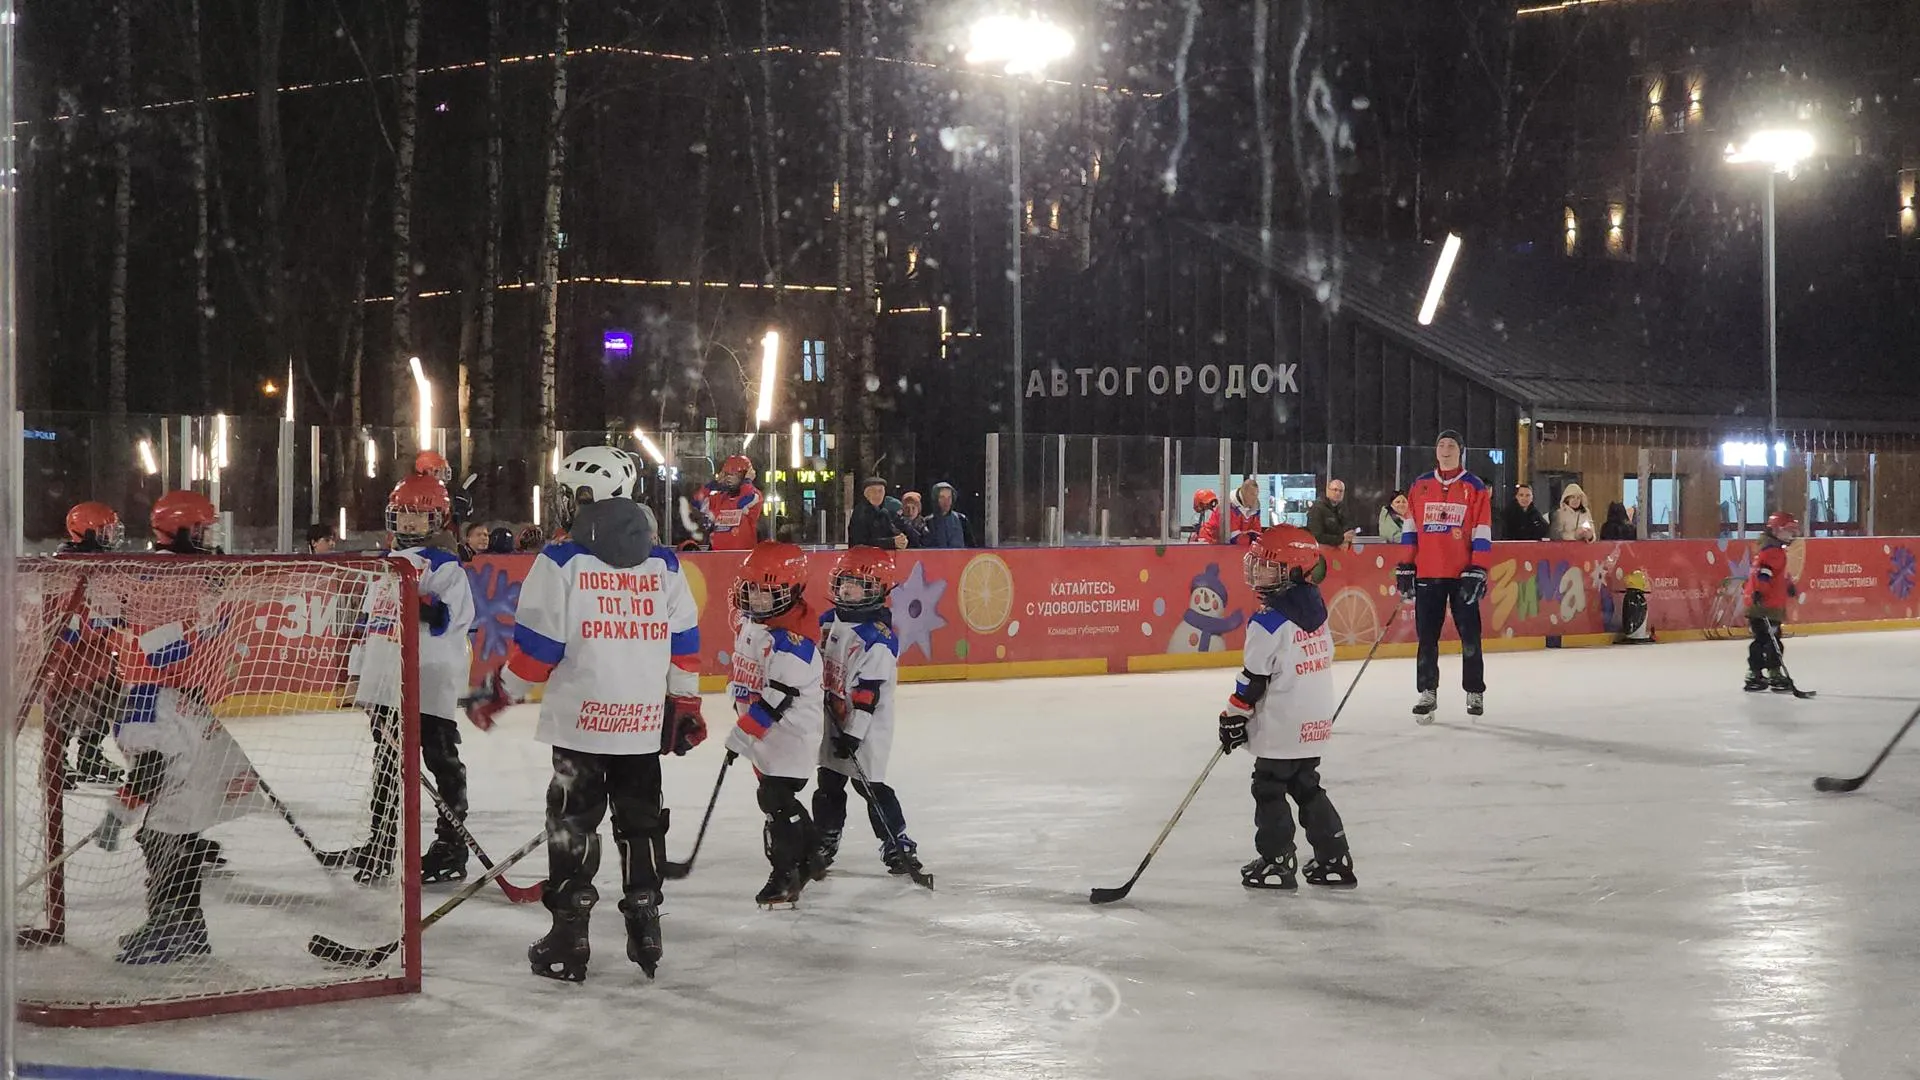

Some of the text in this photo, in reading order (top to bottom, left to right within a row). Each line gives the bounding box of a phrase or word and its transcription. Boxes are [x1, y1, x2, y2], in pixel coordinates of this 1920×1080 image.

[1025, 363, 1299, 398] АВТОГОРОДОК
[1425, 512, 1461, 524] МАИНА
[1823, 562, 1863, 574] КАТАЙТЕСЬ
[579, 572, 662, 595] ПОБЕЖДАЕ
[1050, 579, 1116, 596] КАТАЙТЕСЬ
[597, 596, 627, 617] ТОТ,
[1026, 599, 1140, 617] С УДОВОЛЬСТВИЕМ!
[1048, 625, 1119, 637] Команда губернатора
[580, 701, 644, 717] КРАСНАЯ
[575, 715, 640, 733] МАШИНА
[438, 802, 485, 856] NORDWAY
